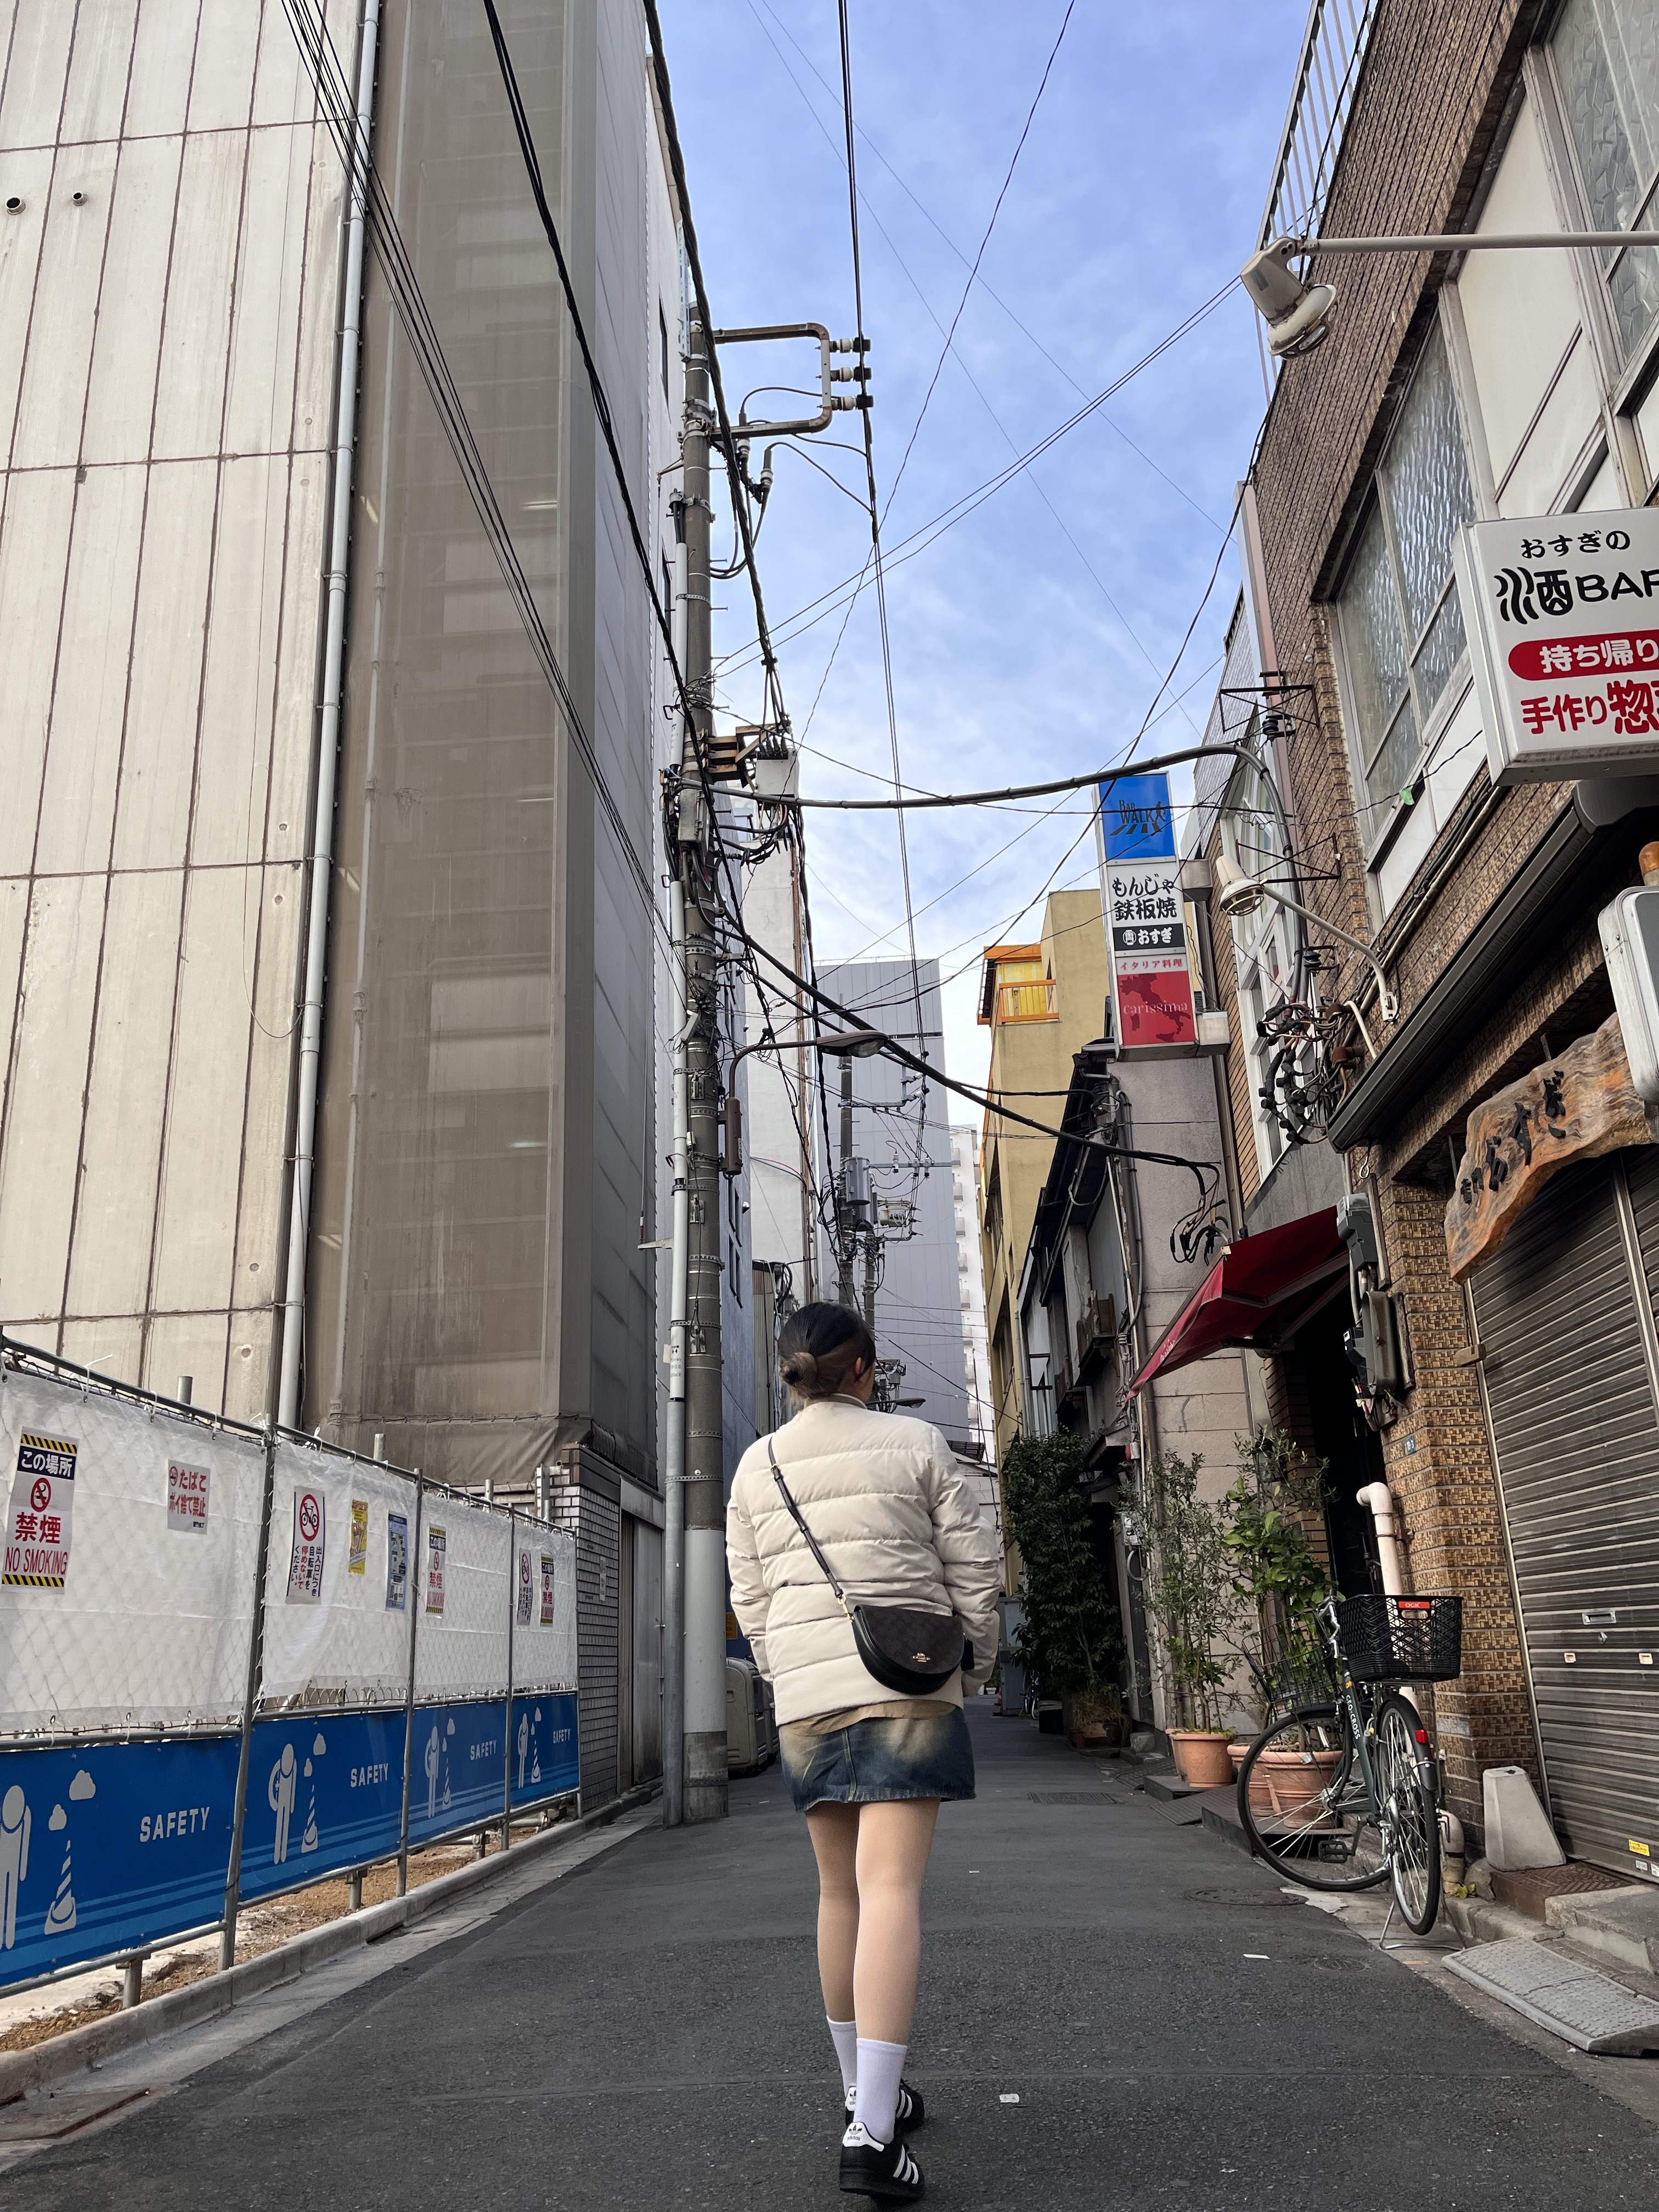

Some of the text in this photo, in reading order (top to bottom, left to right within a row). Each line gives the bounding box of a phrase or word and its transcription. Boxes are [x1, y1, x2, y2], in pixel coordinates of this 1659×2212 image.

[1521, 531, 1630, 558] おすぎの
[1539, 639, 1659, 674] 持ち帰り
[1520, 680, 1659, 734] 手作り惣
[1120, 810, 1154, 824] WALK
[1113, 873, 1174, 897] もんじゃ
[1114, 897, 1177, 921] 鉄板焼
[1138, 927, 1172, 945] おすぎ
[1120, 958, 1183, 970] イタリア料理
[1123, 1000, 1187, 1014] carissima
[21, 1451, 72, 1477] この場所
[178, 1469, 206, 1492] たばこ
[15, 1511, 61, 1544] 禁煙
[5, 1547, 68, 1576] NO SMOKING
[298, 1545, 308, 1589] 停めないで
[305, 1546, 314, 1590] 自転車を
[311, 1546, 321, 1596] 出入口につき
[552, 1728, 571, 1744] SAFETY
[470, 1739, 497, 1760] SAFETY
[350, 1763, 389, 1788] SAFETY
[139, 1806, 210, 1842] SAFETY
